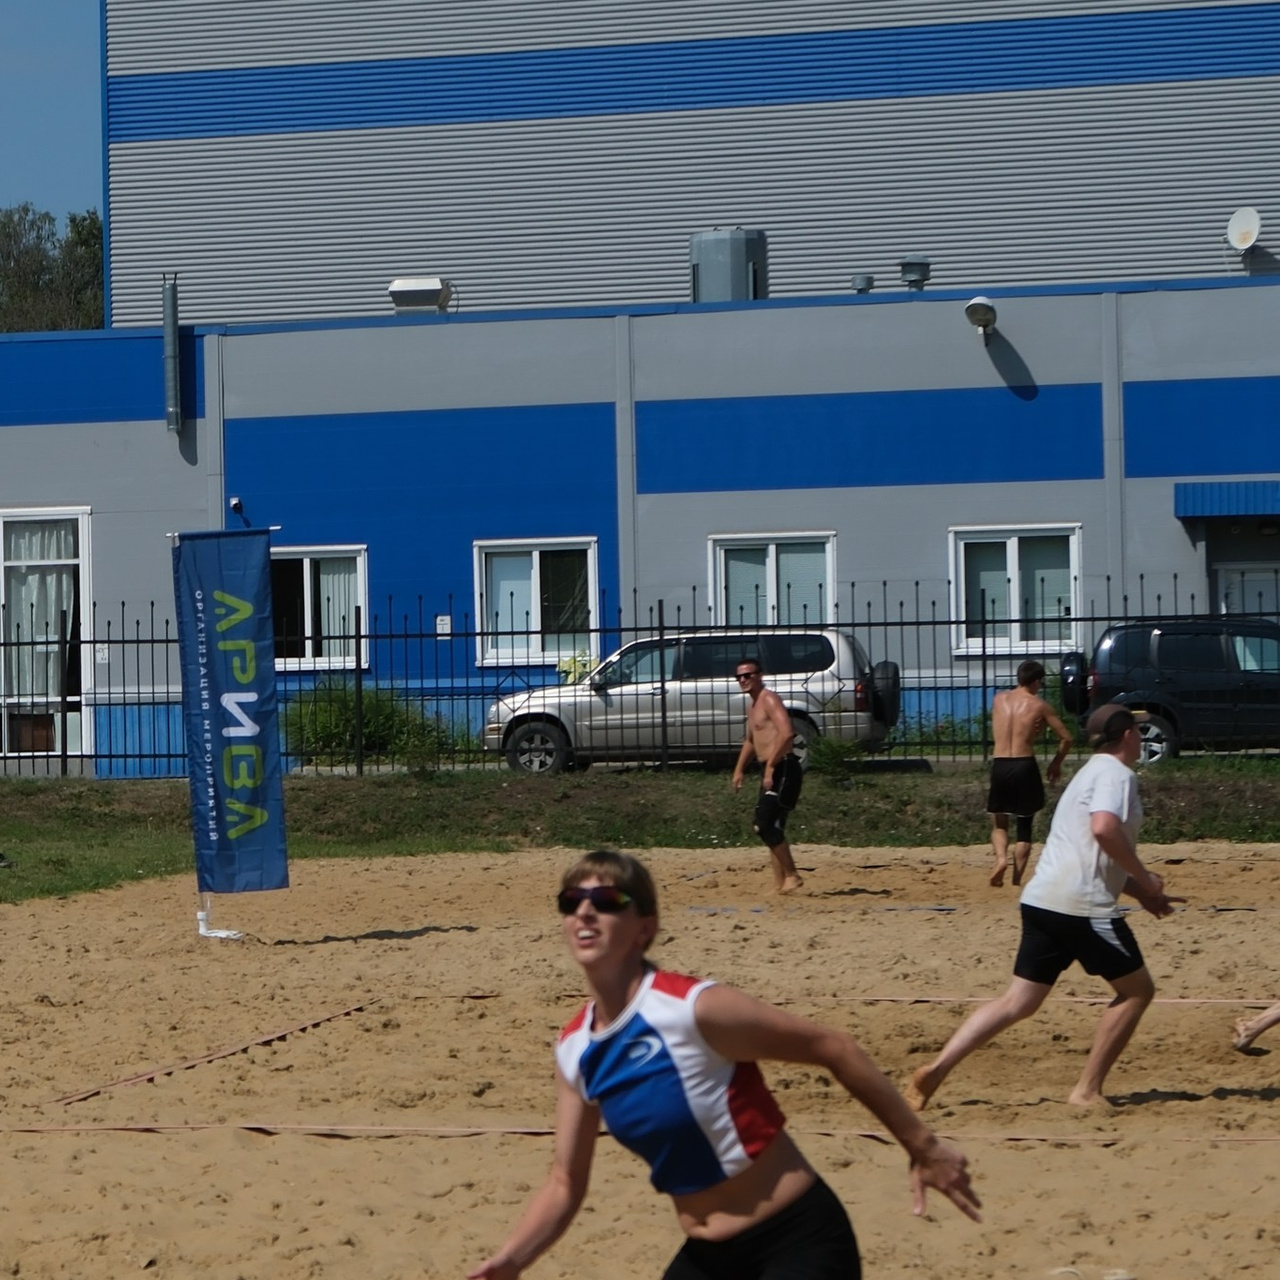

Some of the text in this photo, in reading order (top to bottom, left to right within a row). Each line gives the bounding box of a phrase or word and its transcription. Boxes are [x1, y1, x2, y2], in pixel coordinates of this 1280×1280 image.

[195, 590, 218, 841] ОРГАНИЗАЦИЯ МЕРОПРИЯТИЙ
[213, 590, 269, 840] АРИВА
